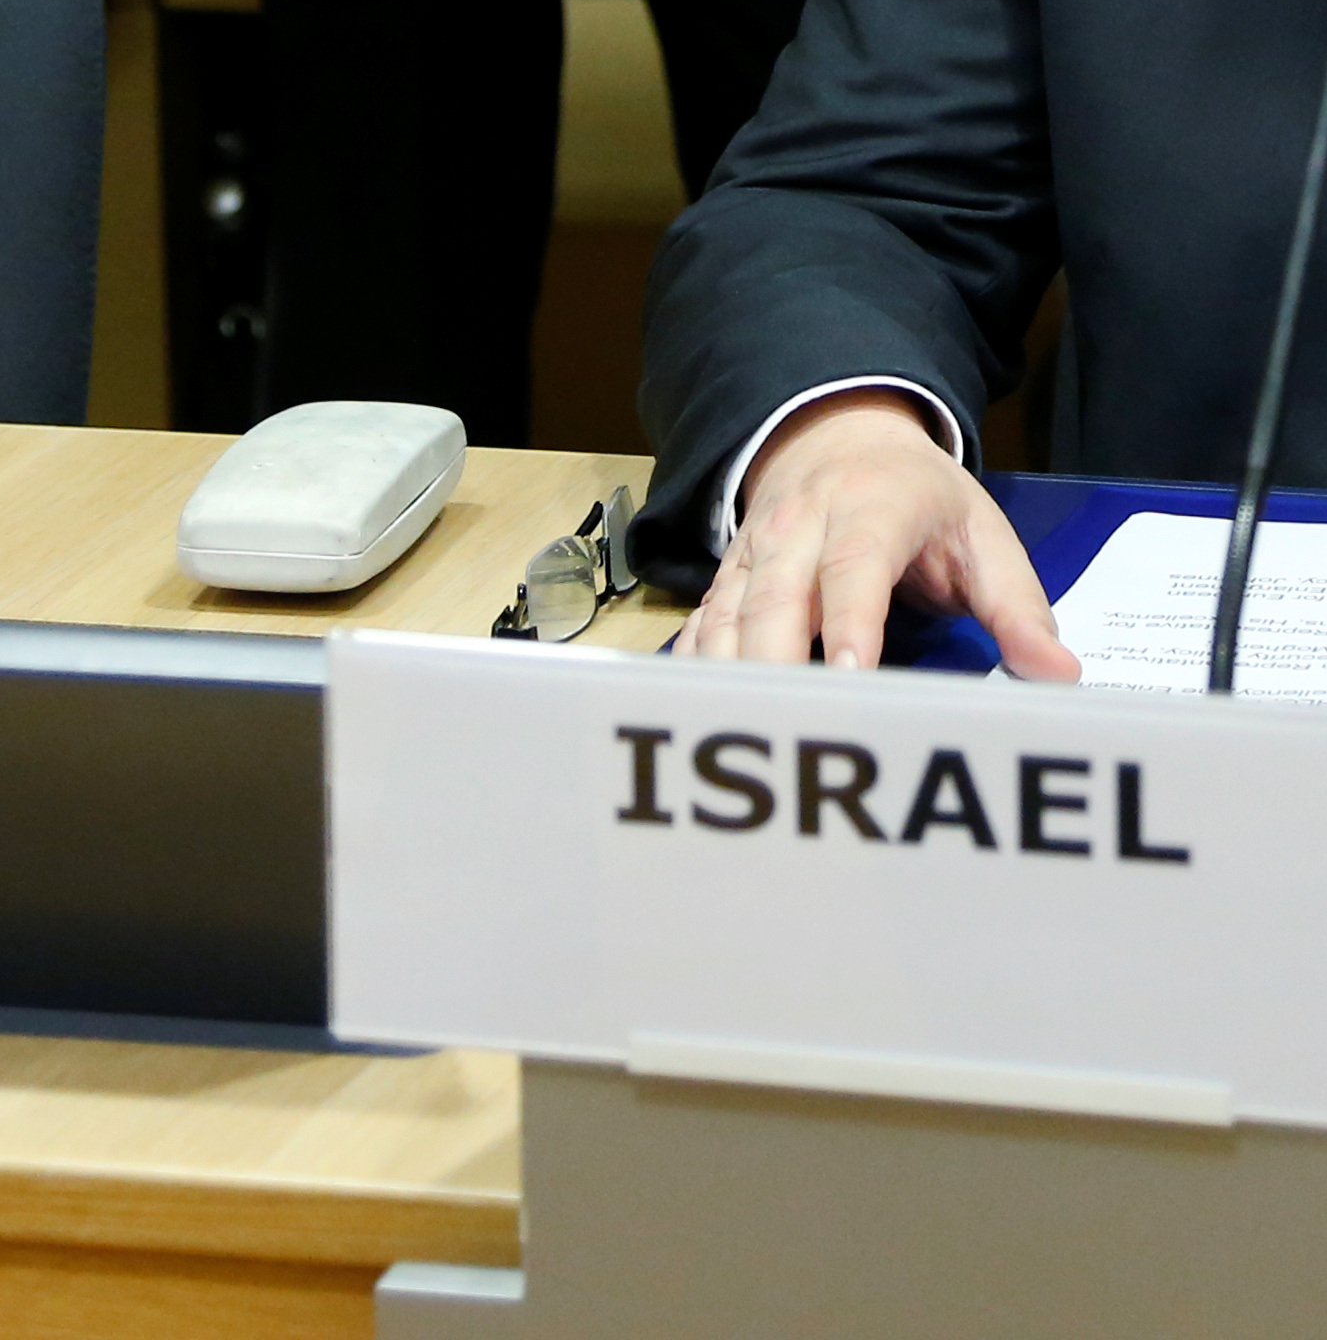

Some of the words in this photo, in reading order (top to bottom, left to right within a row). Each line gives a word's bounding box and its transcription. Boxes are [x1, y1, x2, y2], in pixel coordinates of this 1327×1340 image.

[1292, 595, 1325, 603] for
[1103, 621, 1136, 629] for
[1249, 618, 1288, 626] His
[1080, 652, 1114, 661] for
[1121, 656, 1312, 671] Reprentative
[615, 724, 1191, 867] ISRAEL
